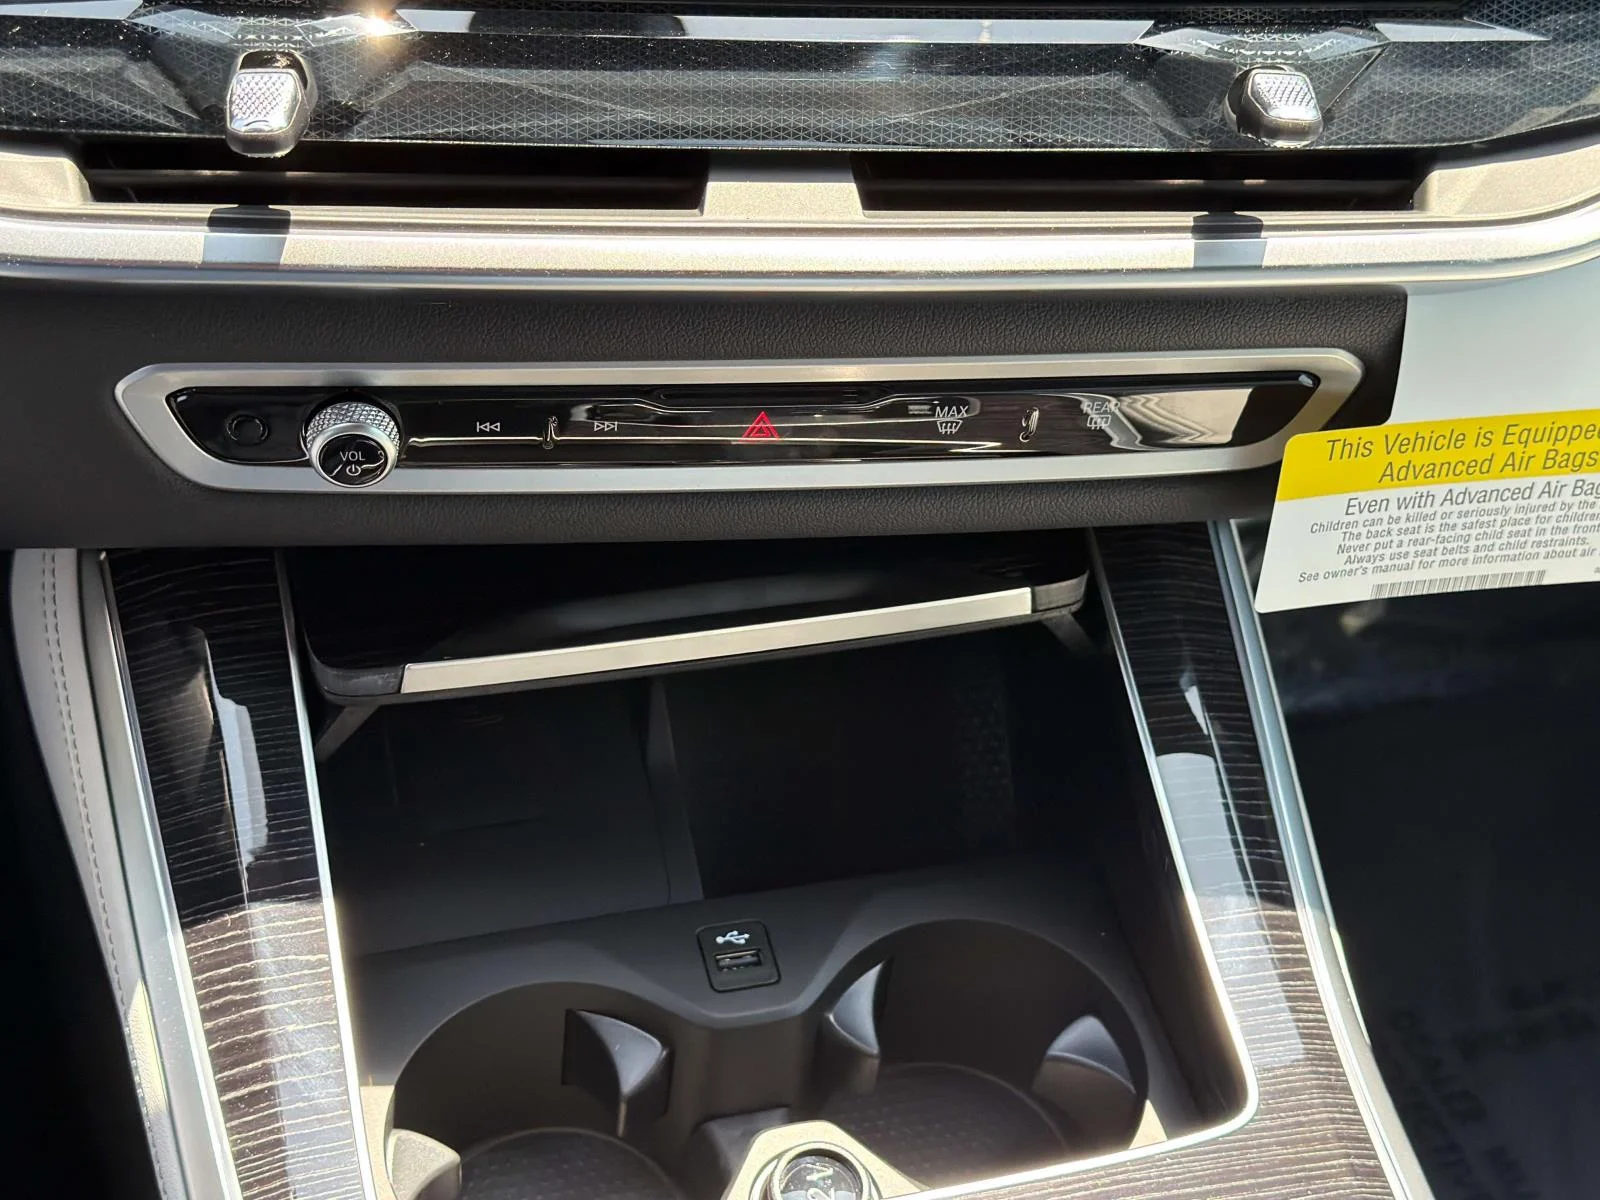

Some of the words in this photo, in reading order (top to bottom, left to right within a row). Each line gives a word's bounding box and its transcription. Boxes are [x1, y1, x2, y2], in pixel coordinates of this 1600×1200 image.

[935, 405, 969, 418] MAX
[1083, 401, 1121, 414] REAR
[340, 450, 366, 461] VOL
[1327, 437, 1374, 461] This
[1384, 428, 1466, 455] Vehicle
[1474, 427, 1494, 448] is
[1502, 421, 1600, 449] Equippe
[1378, 453, 1494, 483] Advanced
[1500, 451, 1536, 473] Air
[1542, 448, 1599, 472] Bags
[1345, 497, 1390, 516] Even
[1397, 490, 1435, 511] with
[1440, 481, 1534, 506] Advanced
[1537, 480, 1567, 499] Air
[1310, 519, 1359, 534] Children
[1362, 516, 1384, 528] can
[1387, 514, 1401, 525] be
[1405, 511, 1437, 524] killed
[1440, 510, 1453, 520] or
[1456, 504, 1511, 520] seriously
[1514, 501, 1556, 516] injured
[1560, 501, 1574, 513] by
[1578, 499, 1597, 510] the
[1342, 531, 1361, 542] The
[1366, 527, 1393, 540] back
[1396, 523, 1421, 536] seat
[1424, 523, 1435, 533] is
[1440, 521, 1457, 533] the
[1461, 518, 1497, 531] safest
[1499, 515, 1531, 529] place
[1534, 515, 1553, 525] for
[1337, 543, 1371, 555] Never
[1373, 540, 1394, 552] put
[1396, 539, 1404, 548] a
[1407, 533, 1471, 548] rear-facing
[1475, 527, 1503, 541] child
[1507, 526, 1531, 539] seat
[1535, 526, 1546, 537] in
[1550, 524, 1569, 535] the
[1573, 522, 1600, 534] front
[1344, 552, 1385, 566] Always
[1389, 550, 1409, 561] use
[1413, 547, 1438, 558] seat
[1441, 545, 1470, 556] belts
[1473, 542, 1495, 553] and
[1498, 539, 1527, 551] child
[1530, 535, 1590, 549] restraints.
[1298, 571, 1319, 583] See
[1323, 565, 1368, 580] owner's
[1372, 561, 1414, 574] manual
[1417, 559, 1434, 570] for
[1438, 556, 1468, 568] more
[1471, 550, 1541, 565] information
[1543, 547, 1577, 560] about
[1579, 546, 1597, 557] air
